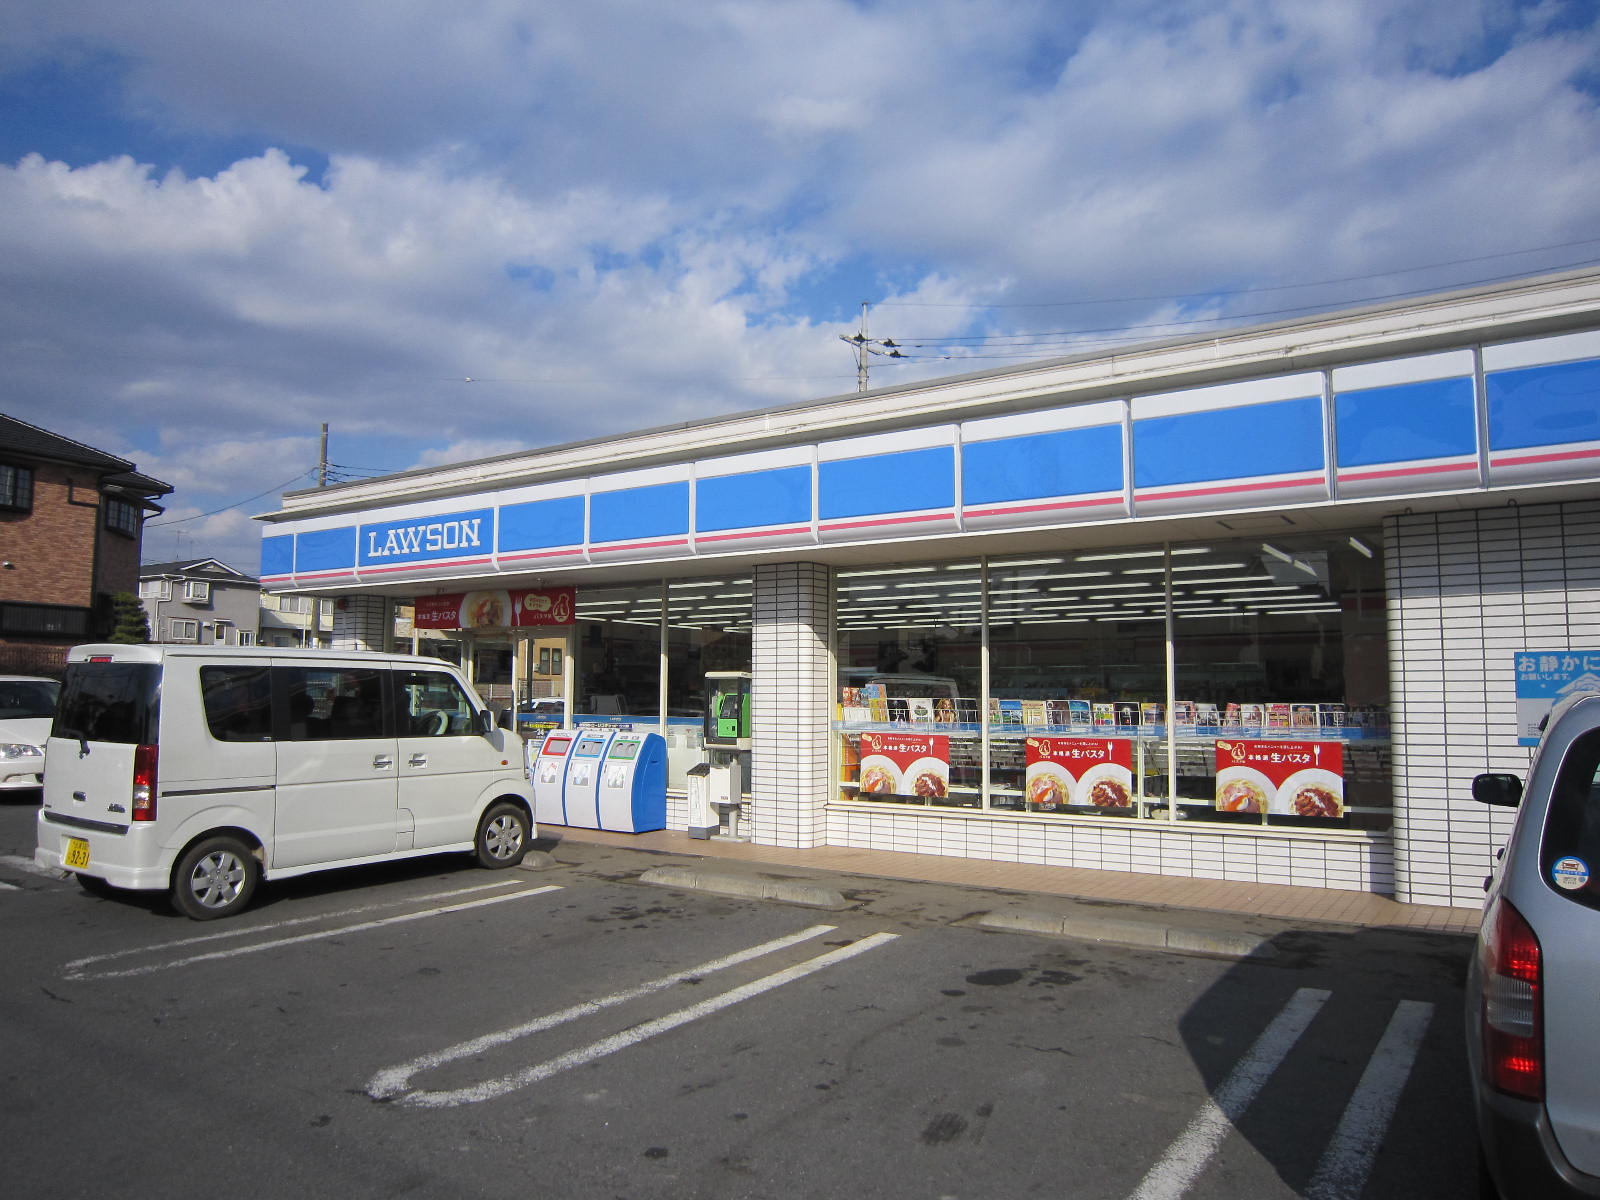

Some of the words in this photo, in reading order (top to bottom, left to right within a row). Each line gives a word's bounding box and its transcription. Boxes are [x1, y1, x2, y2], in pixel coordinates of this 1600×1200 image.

[368, 518, 481, 557] LAWSON
[1518, 655, 1600, 672] お静かに
[899, 743, 927, 753] 生パスタ
[1071, 748, 1105, 759] 生パスタ
[1270, 752, 1311, 763] 生パスタ
